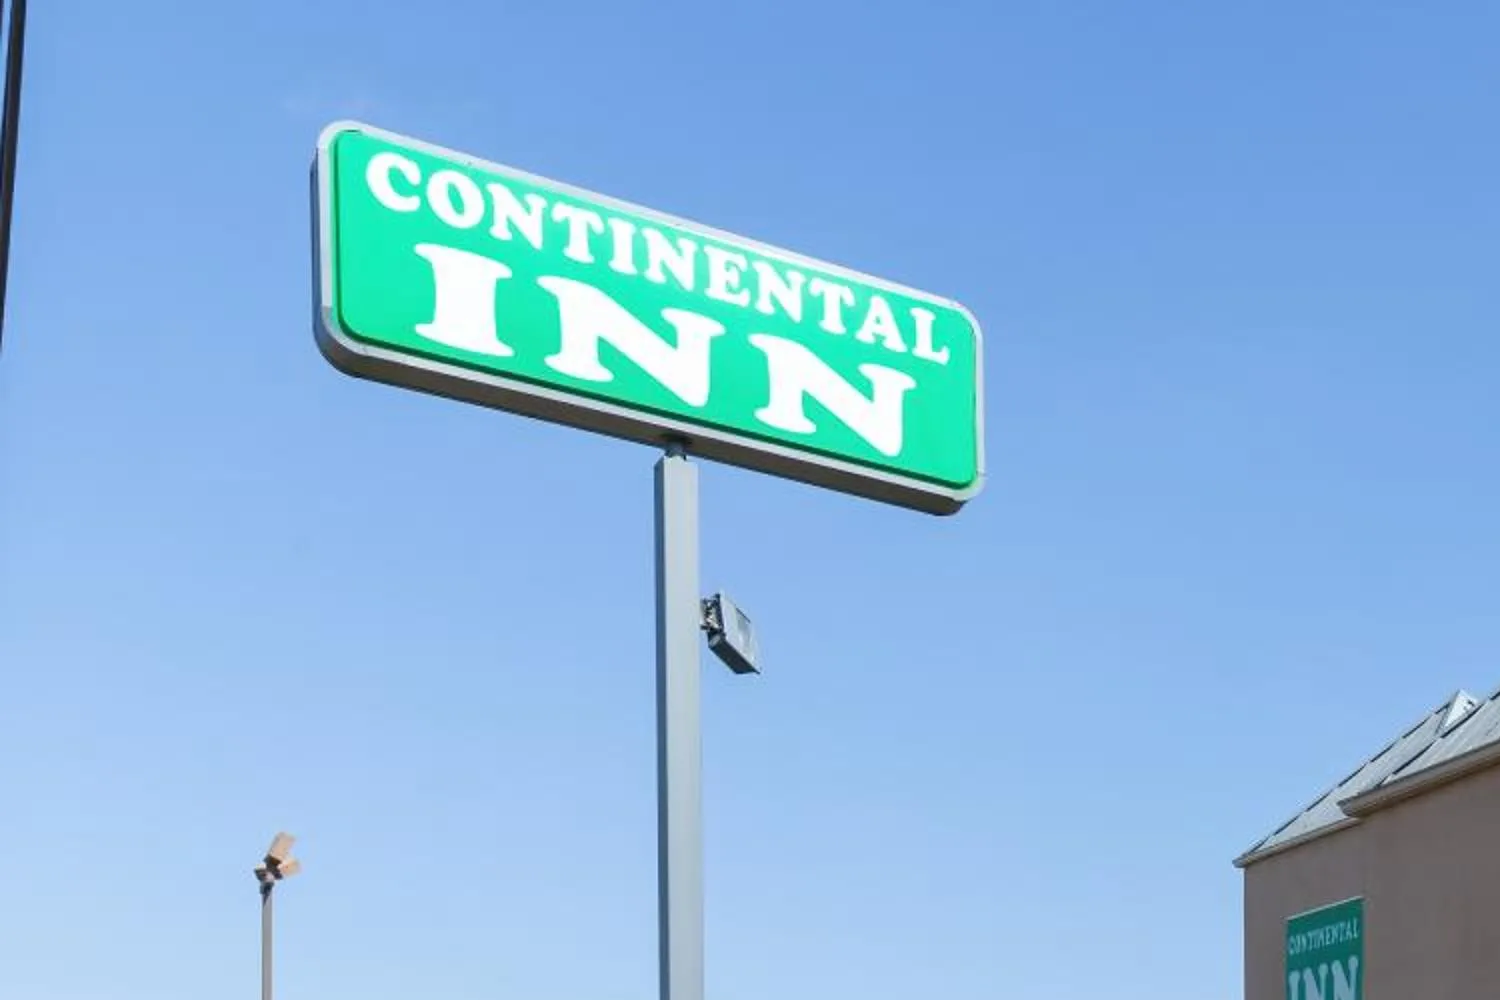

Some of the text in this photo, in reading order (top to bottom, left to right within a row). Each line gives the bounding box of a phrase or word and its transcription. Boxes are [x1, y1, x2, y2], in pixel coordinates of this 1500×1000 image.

[366, 152, 950, 364] CONTINENTAL
[414, 243, 917, 457] INN
[1289, 917, 1359, 954] CONTINENTAL
